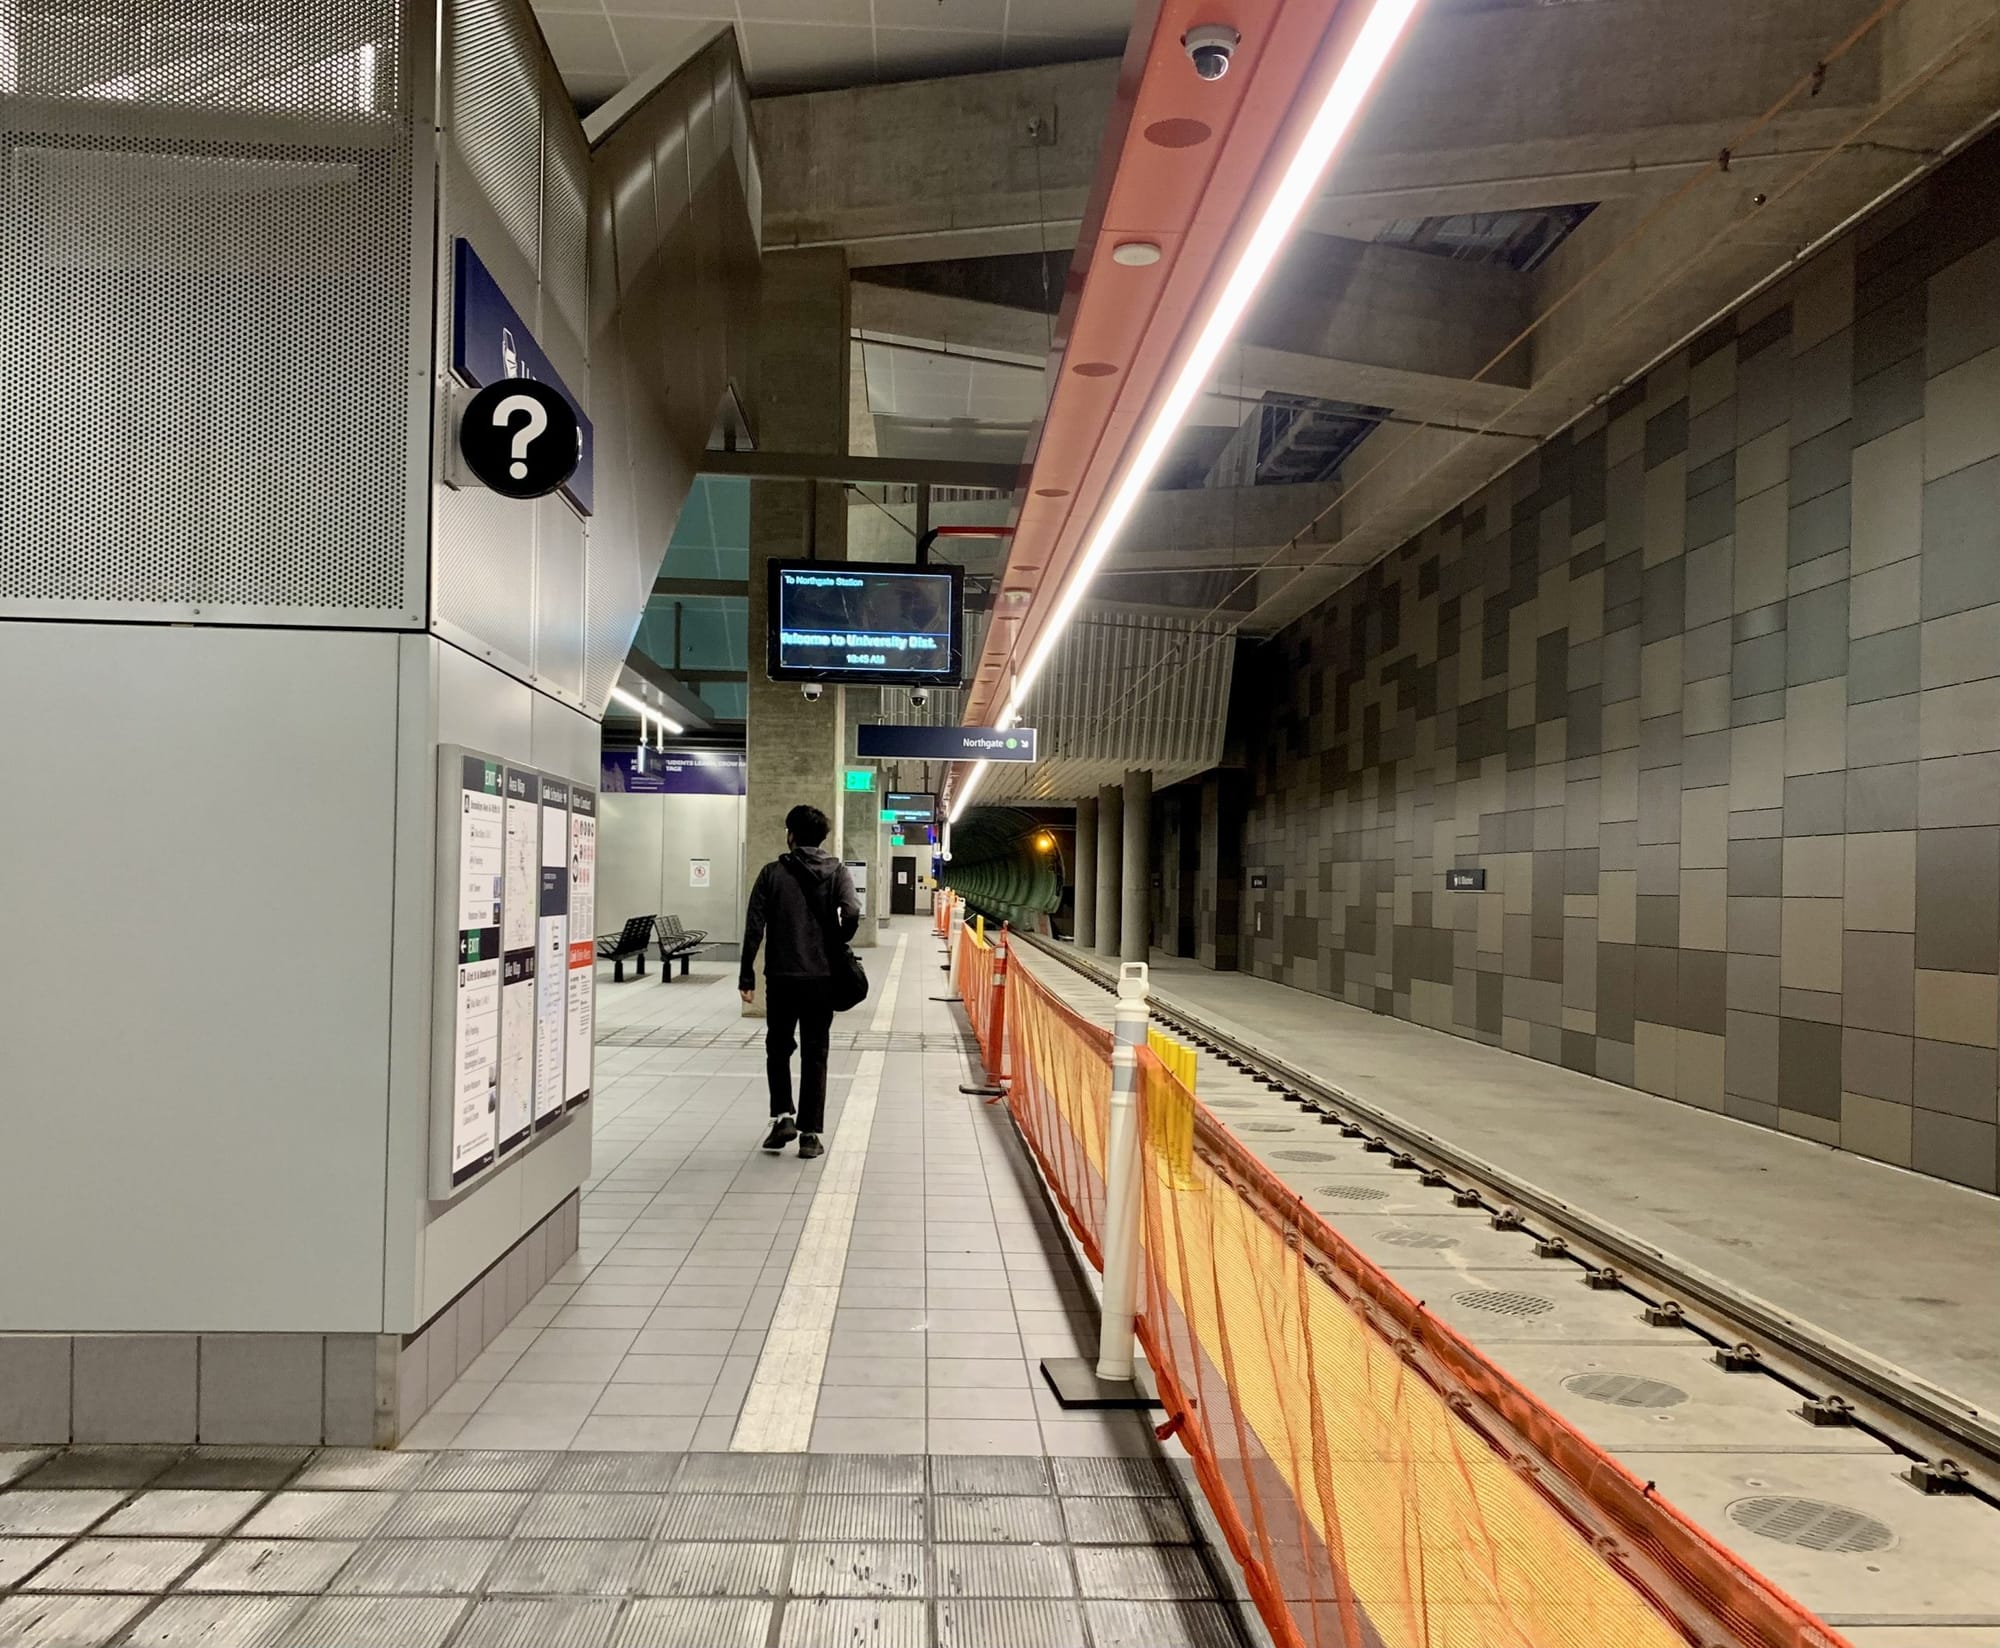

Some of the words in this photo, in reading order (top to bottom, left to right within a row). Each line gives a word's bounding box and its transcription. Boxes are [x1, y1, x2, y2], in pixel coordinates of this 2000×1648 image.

[784, 575, 795, 585] To
[796, 576, 835, 588] Northgate
[835, 577, 864, 587] Station
[831, 634, 846, 647] to
[846, 634, 908, 651] University
[962, 737, 1004, 750] Northgate
